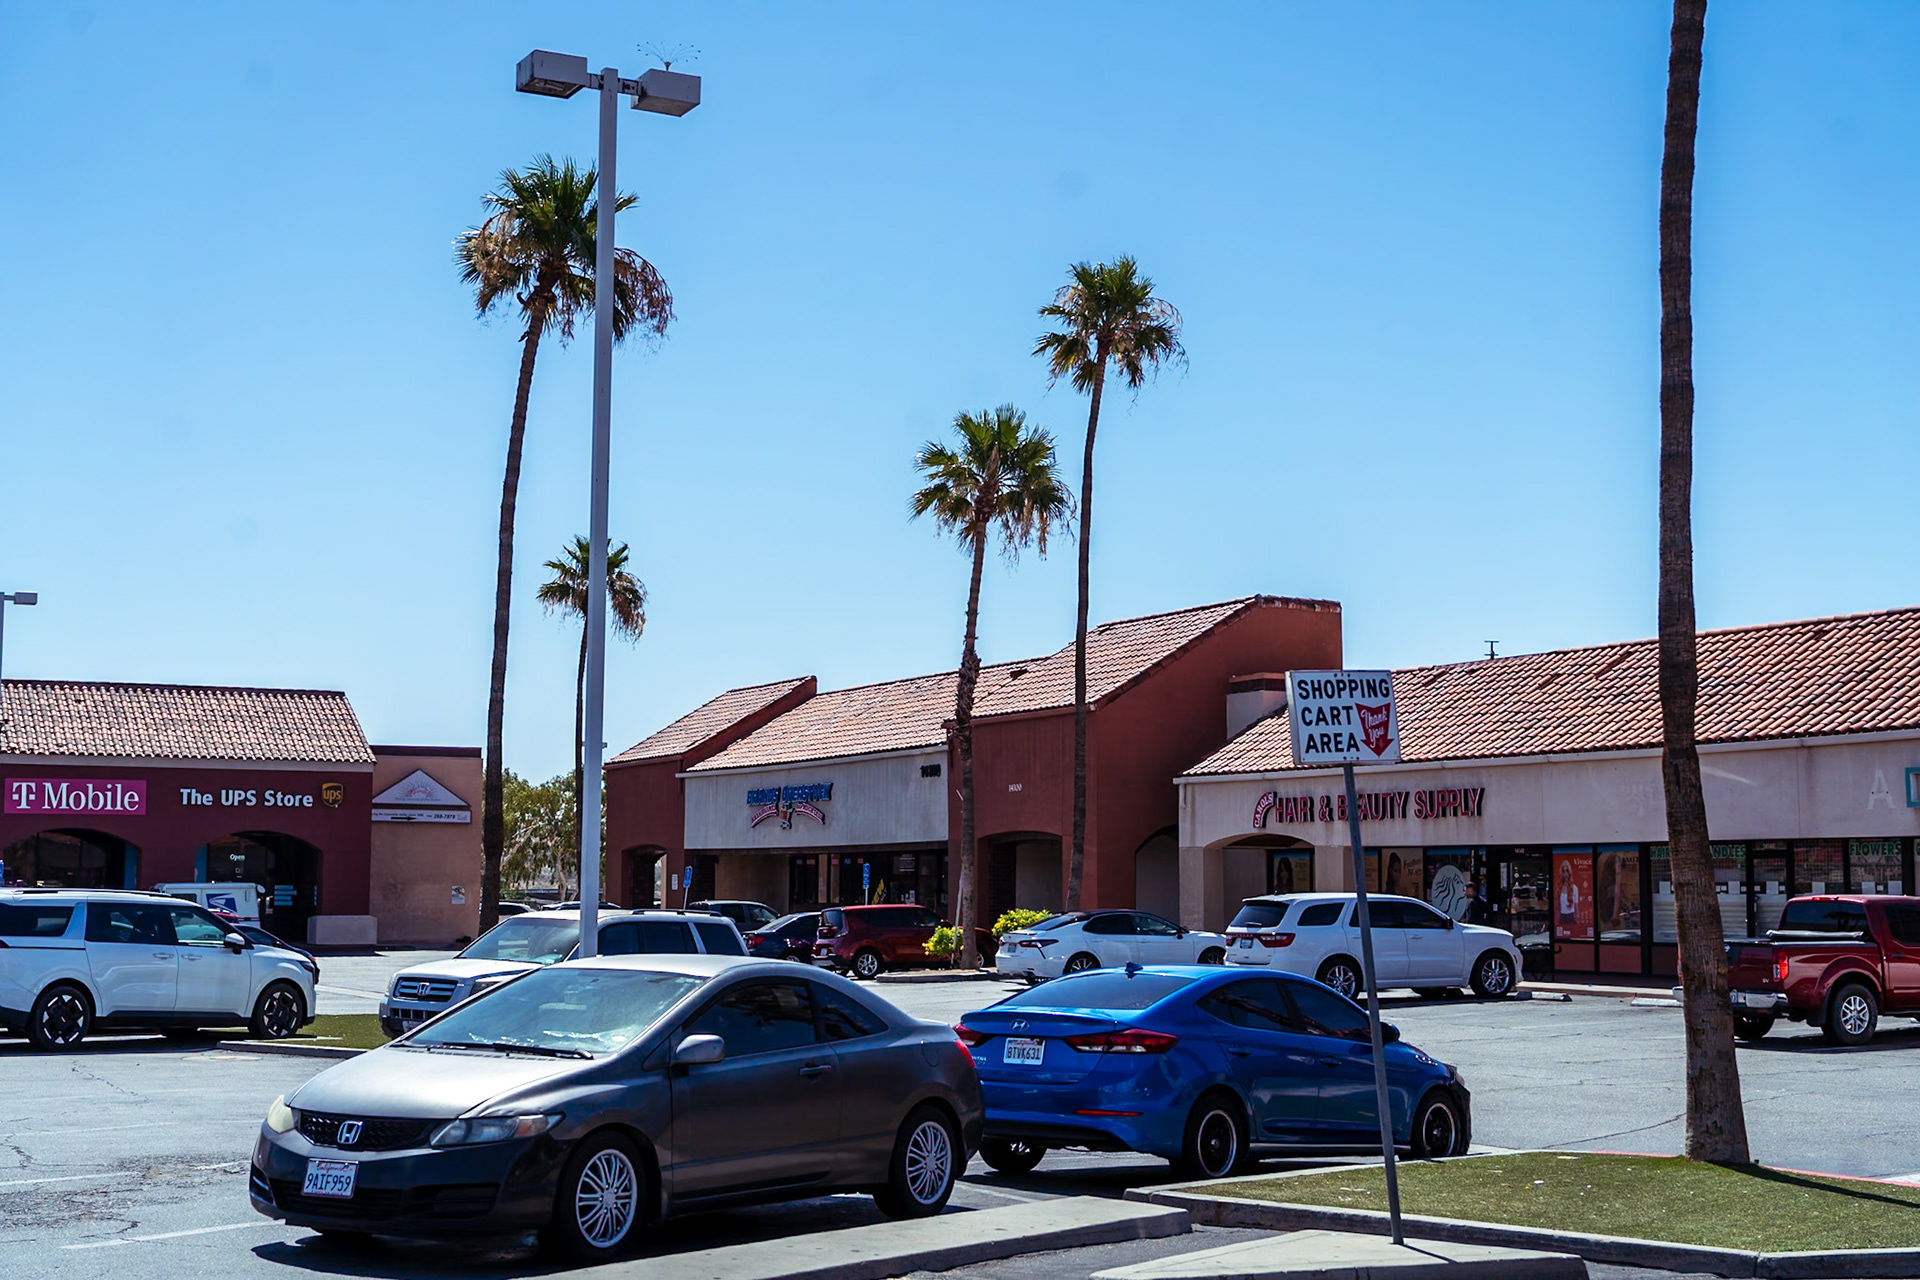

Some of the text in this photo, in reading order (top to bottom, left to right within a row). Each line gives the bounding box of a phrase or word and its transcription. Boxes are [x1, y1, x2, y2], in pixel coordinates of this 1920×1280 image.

[1297, 678, 1390, 700] SHOPPING
[1301, 705, 1353, 727] CART
[1361, 707, 1388, 730] Thank
[1305, 732, 1360, 754] AREA
[1368, 726, 1385, 748] You
[42, 782, 140, 811] Mobile
[180, 788, 314, 807] The UPS Store
[323, 789, 342, 804] ups
[1275, 788, 1484, 823] HAIR & BAUTY SUPPLY
[229, 853, 246, 862] Open
[1849, 843, 1902, 856] FLOWERS
[305, 1172, 352, 1192] 9AIF959
